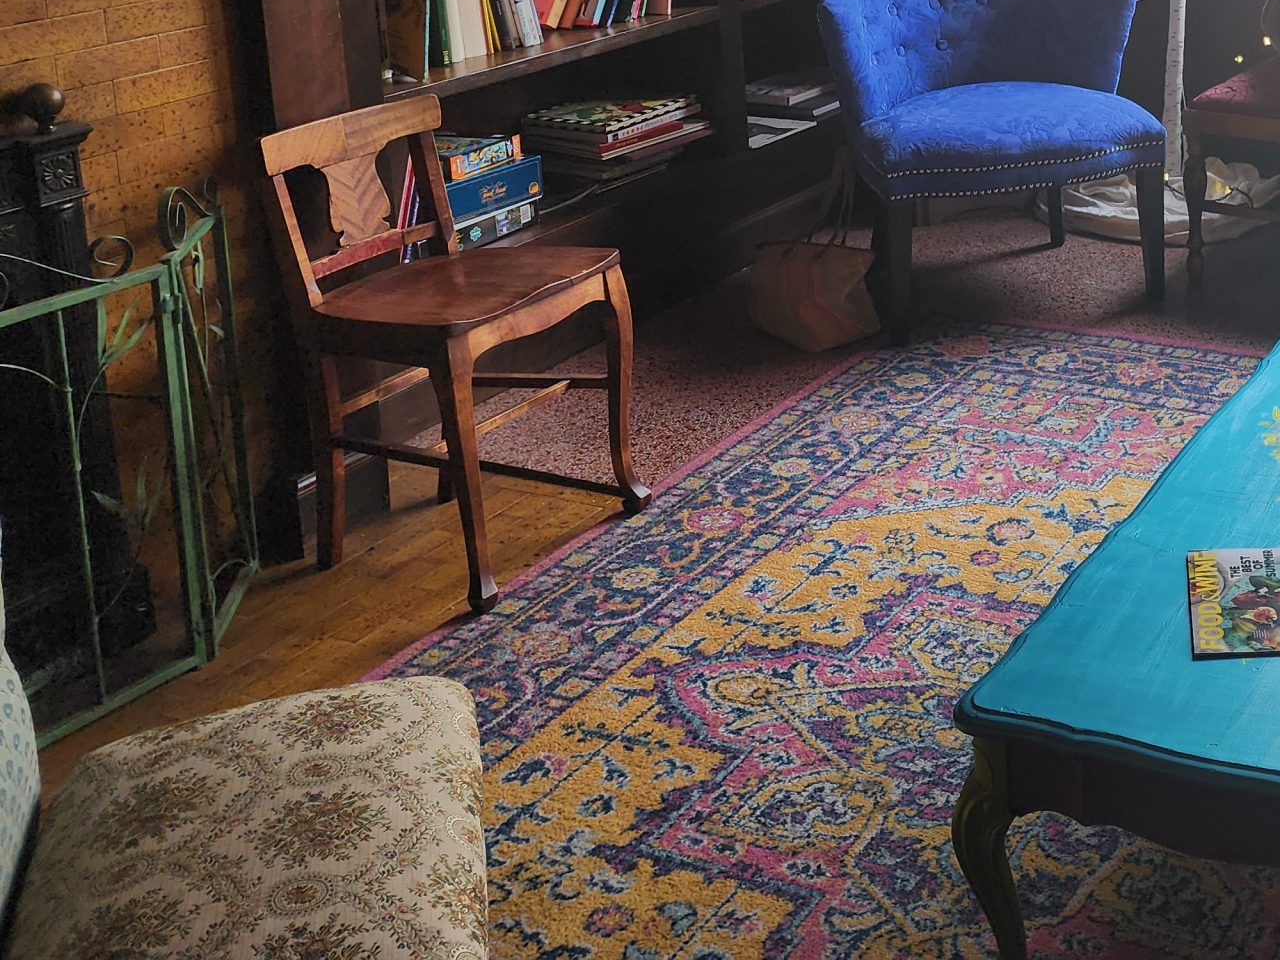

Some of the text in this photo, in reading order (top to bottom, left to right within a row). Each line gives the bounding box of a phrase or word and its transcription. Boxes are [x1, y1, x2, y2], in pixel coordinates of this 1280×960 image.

[1240, 555, 1253, 573] BEST
[1252, 559, 1263, 570] OF
[1262, 549, 1277, 578] SUMMER
[1229, 565, 1242, 579] THE
